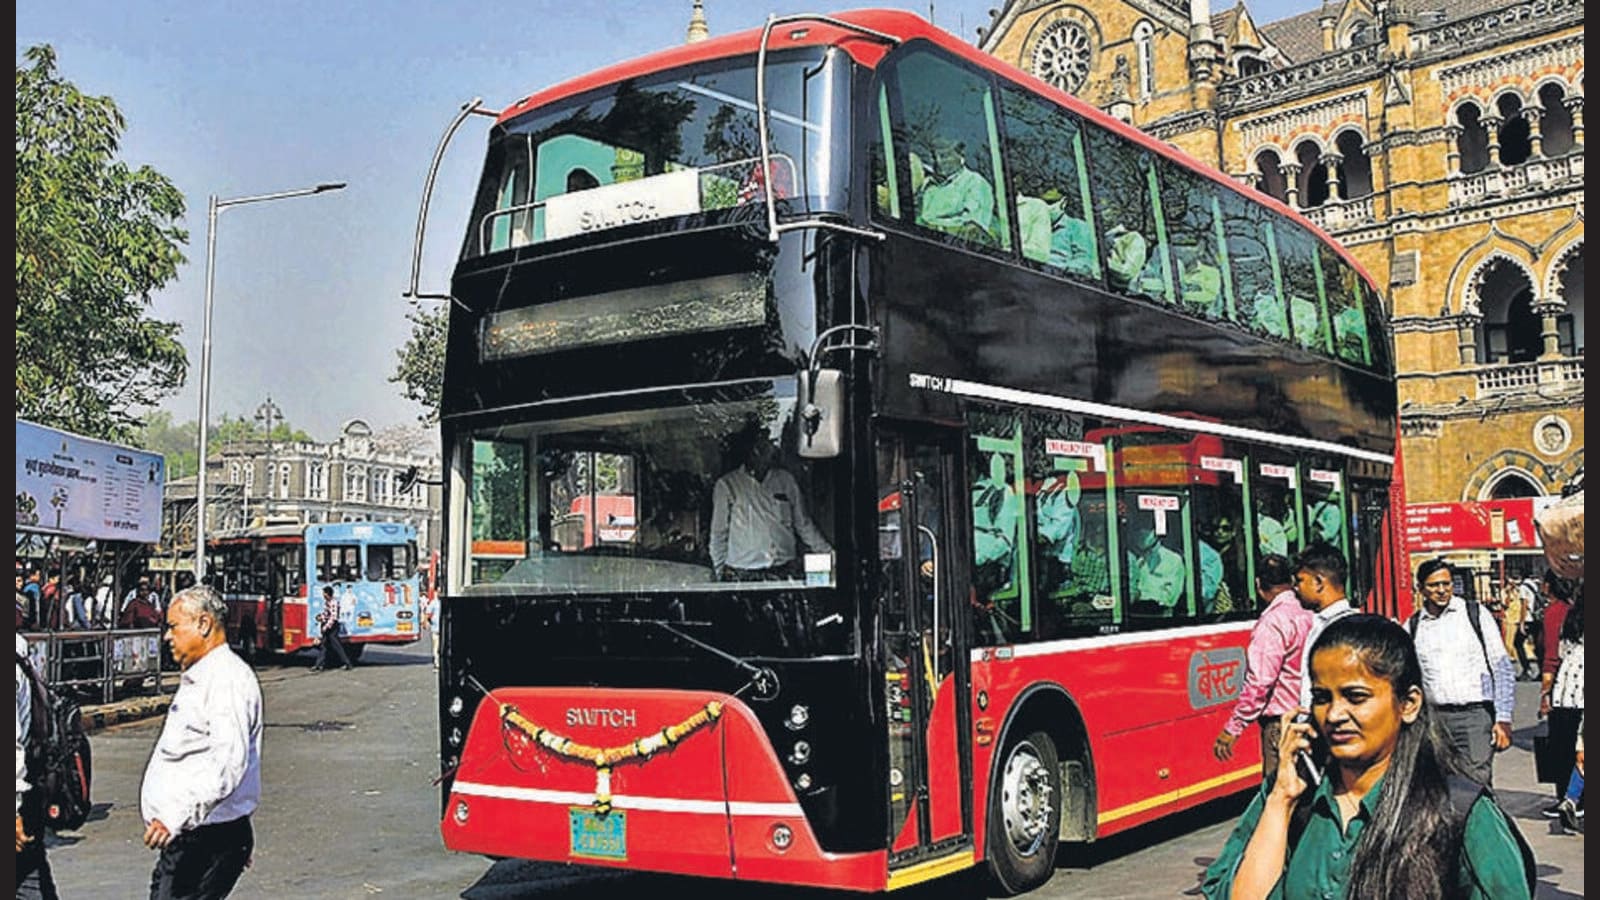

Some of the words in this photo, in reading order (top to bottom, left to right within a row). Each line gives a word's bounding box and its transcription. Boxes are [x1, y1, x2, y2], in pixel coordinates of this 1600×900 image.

[909, 373, 943, 391] SWITCH
[1197, 654, 1240, 700] बेस्ट
[566, 708, 637, 728] SWITCH
